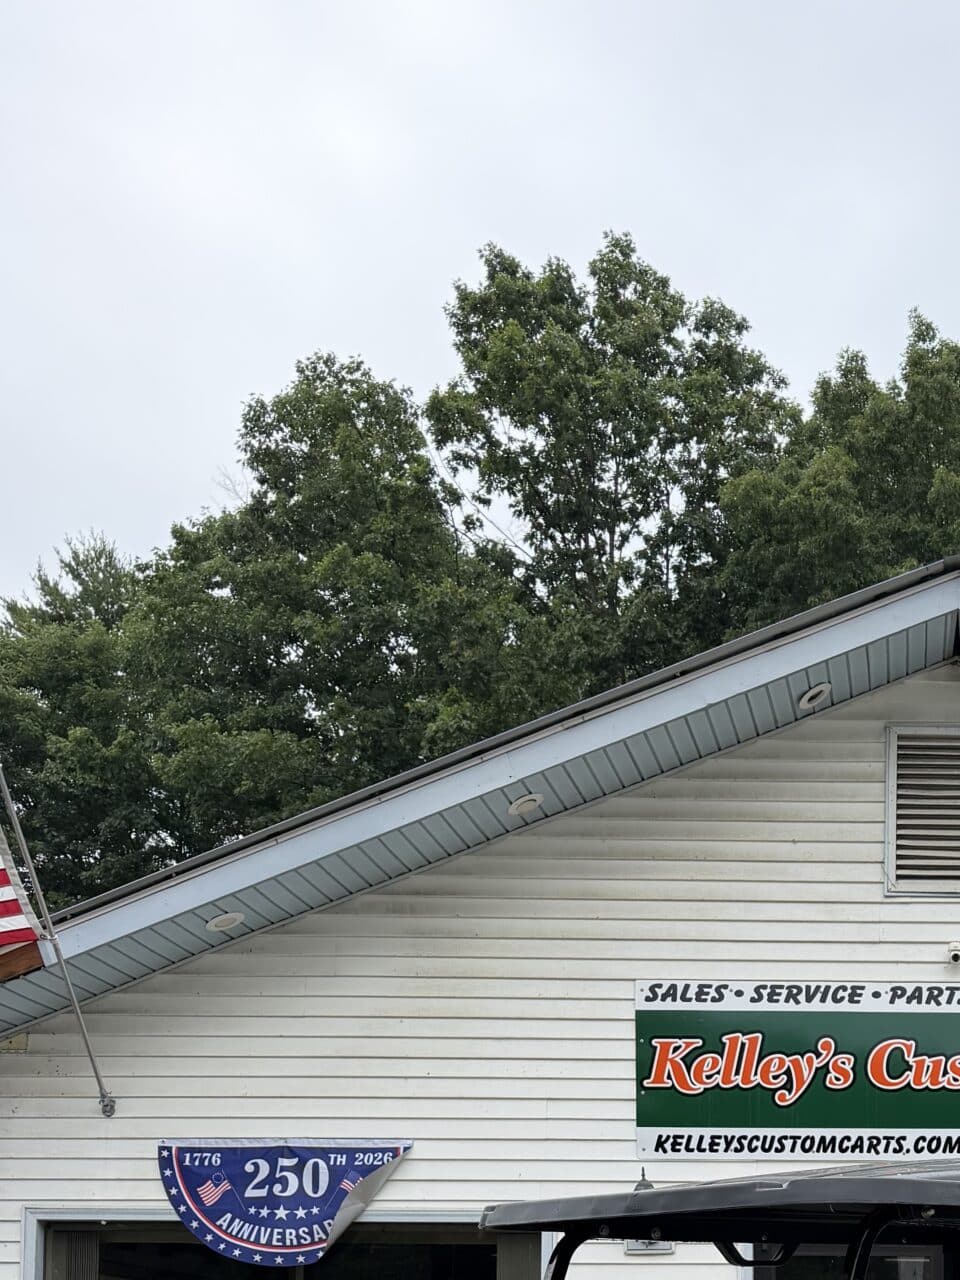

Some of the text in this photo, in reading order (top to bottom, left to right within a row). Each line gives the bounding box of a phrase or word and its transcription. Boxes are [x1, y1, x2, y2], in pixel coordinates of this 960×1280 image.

[644, 983, 727, 1003] SALES
[750, 984, 863, 1004] SERVICE
[643, 1033, 855, 1106] Kelley's
[183, 1152, 222, 1166] 1776
[354, 1152, 394, 1166] 2026
[215, 1212, 334, 1246] ANNIVERSAR
